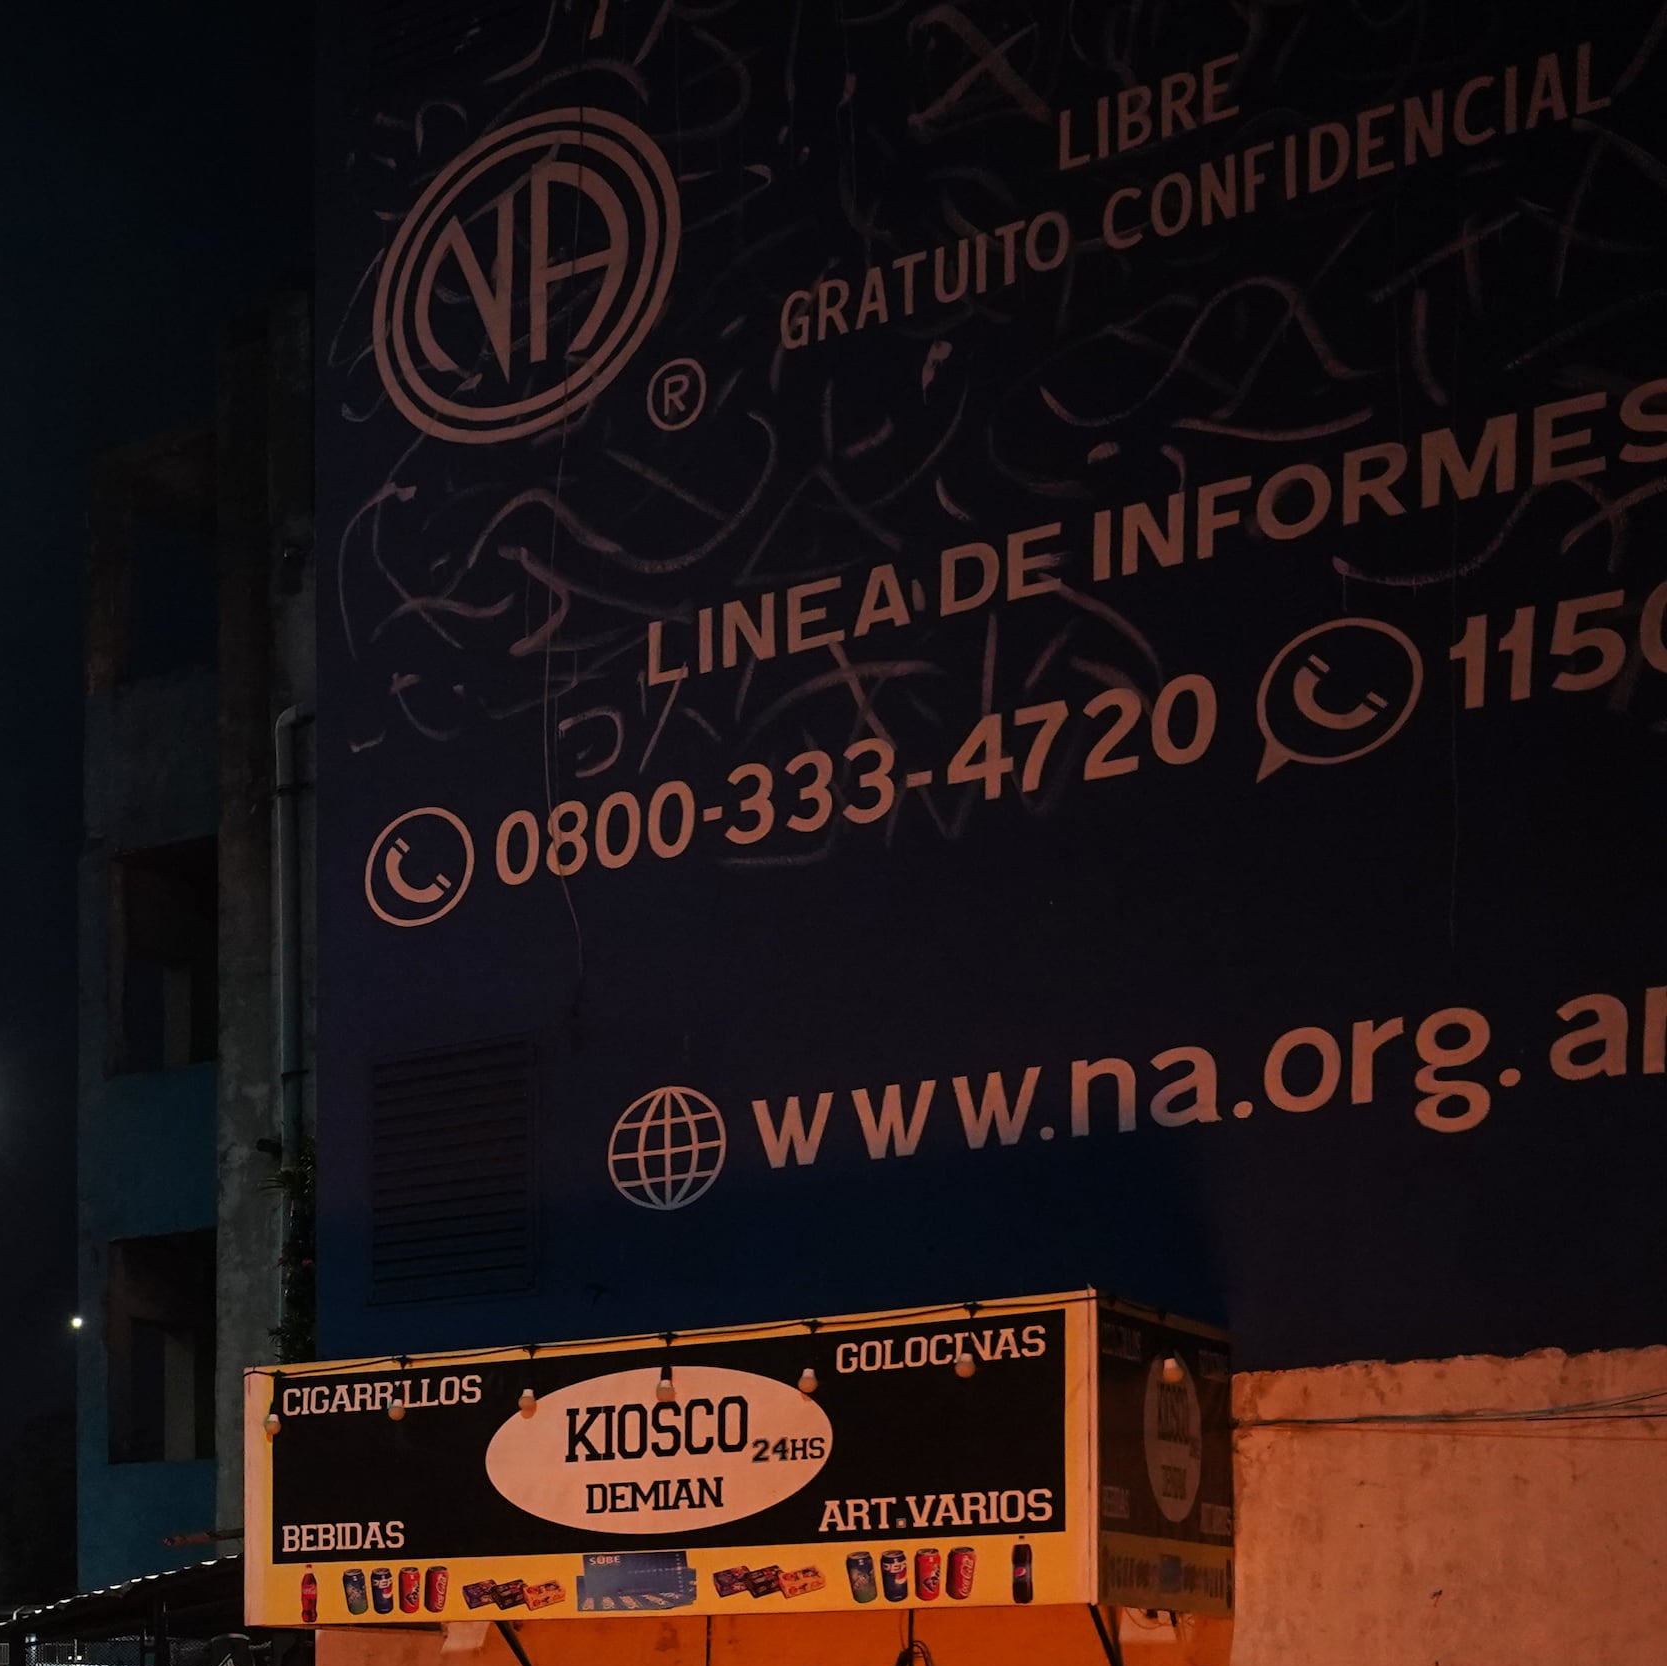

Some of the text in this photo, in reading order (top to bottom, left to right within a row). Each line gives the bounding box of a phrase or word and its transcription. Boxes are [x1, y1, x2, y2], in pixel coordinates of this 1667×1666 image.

[1057, 50, 1242, 172] LIBRE
[779, 41, 1612, 351] GRATUITO CONFIDENCIAL
[646, 376, 1667, 687] LINEA DE INFORMES
[494, 672, 1219, 887] 0800-333-4720
[835, 1324, 1046, 1374] GOLOCINAS
[282, 1374, 483, 1417] CIGARRLLOS
[565, 1395, 825, 1463] KIOSCO 24HS
[585, 1476, 724, 1514] DEMIAN
[281, 1519, 405, 1553] BEBIDAS
